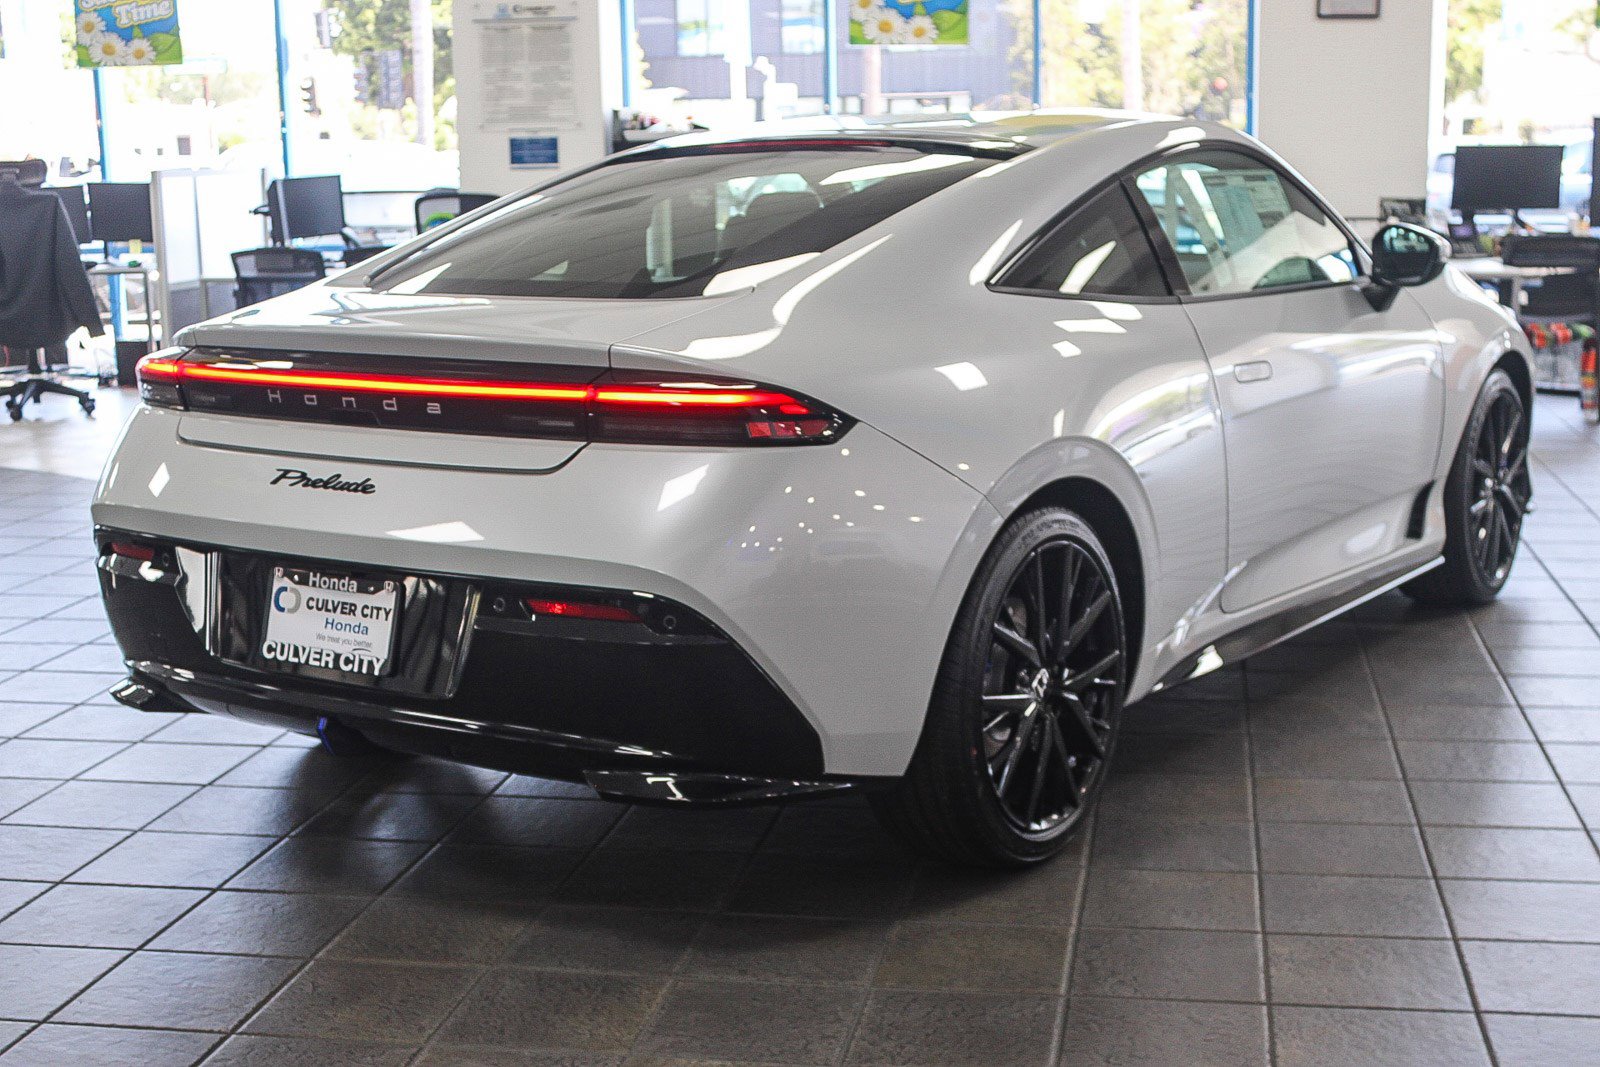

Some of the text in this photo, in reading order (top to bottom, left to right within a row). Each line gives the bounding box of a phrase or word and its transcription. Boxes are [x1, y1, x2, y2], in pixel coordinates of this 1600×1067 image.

[115, 0, 171, 25] Time
[267, 388, 442, 415] Honda
[269, 468, 376, 494] Prelude
[308, 571, 358, 593] Honda
[305, 596, 392, 621] CULVER CITY
[324, 617, 369, 635] Honda
[262, 640, 386, 676] CULVER CITY
